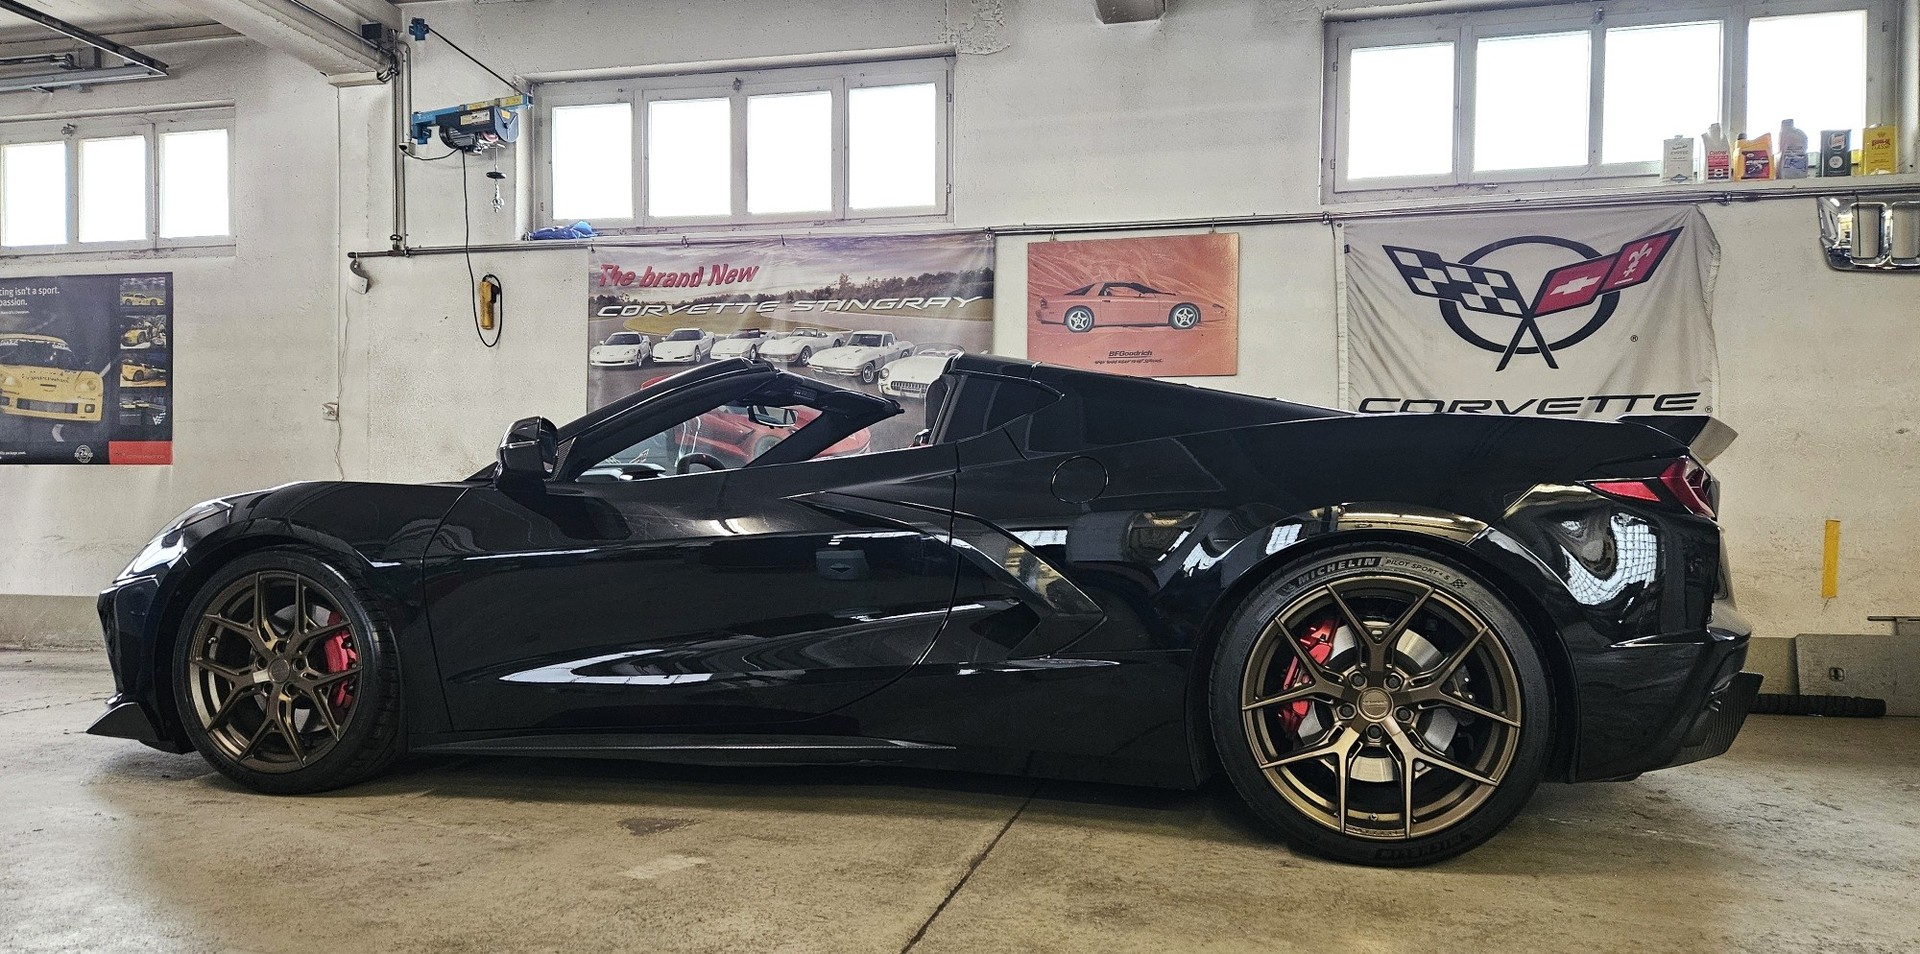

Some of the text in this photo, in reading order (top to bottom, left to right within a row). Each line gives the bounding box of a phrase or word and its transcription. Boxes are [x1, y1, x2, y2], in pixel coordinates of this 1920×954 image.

[600, 263, 760, 288] The brand New
[15, 287, 30, 295] isn't
[38, 286, 60, 296] sport.
[597, 296, 983, 317] CORVETTE STINGRAY
[1358, 392, 1702, 414] CORVETTE
[1298, 557, 1377, 585] MICHELIN
[1385, 559, 1410, 567] PILOT
[1411, 563, 1438, 575] SPORT
